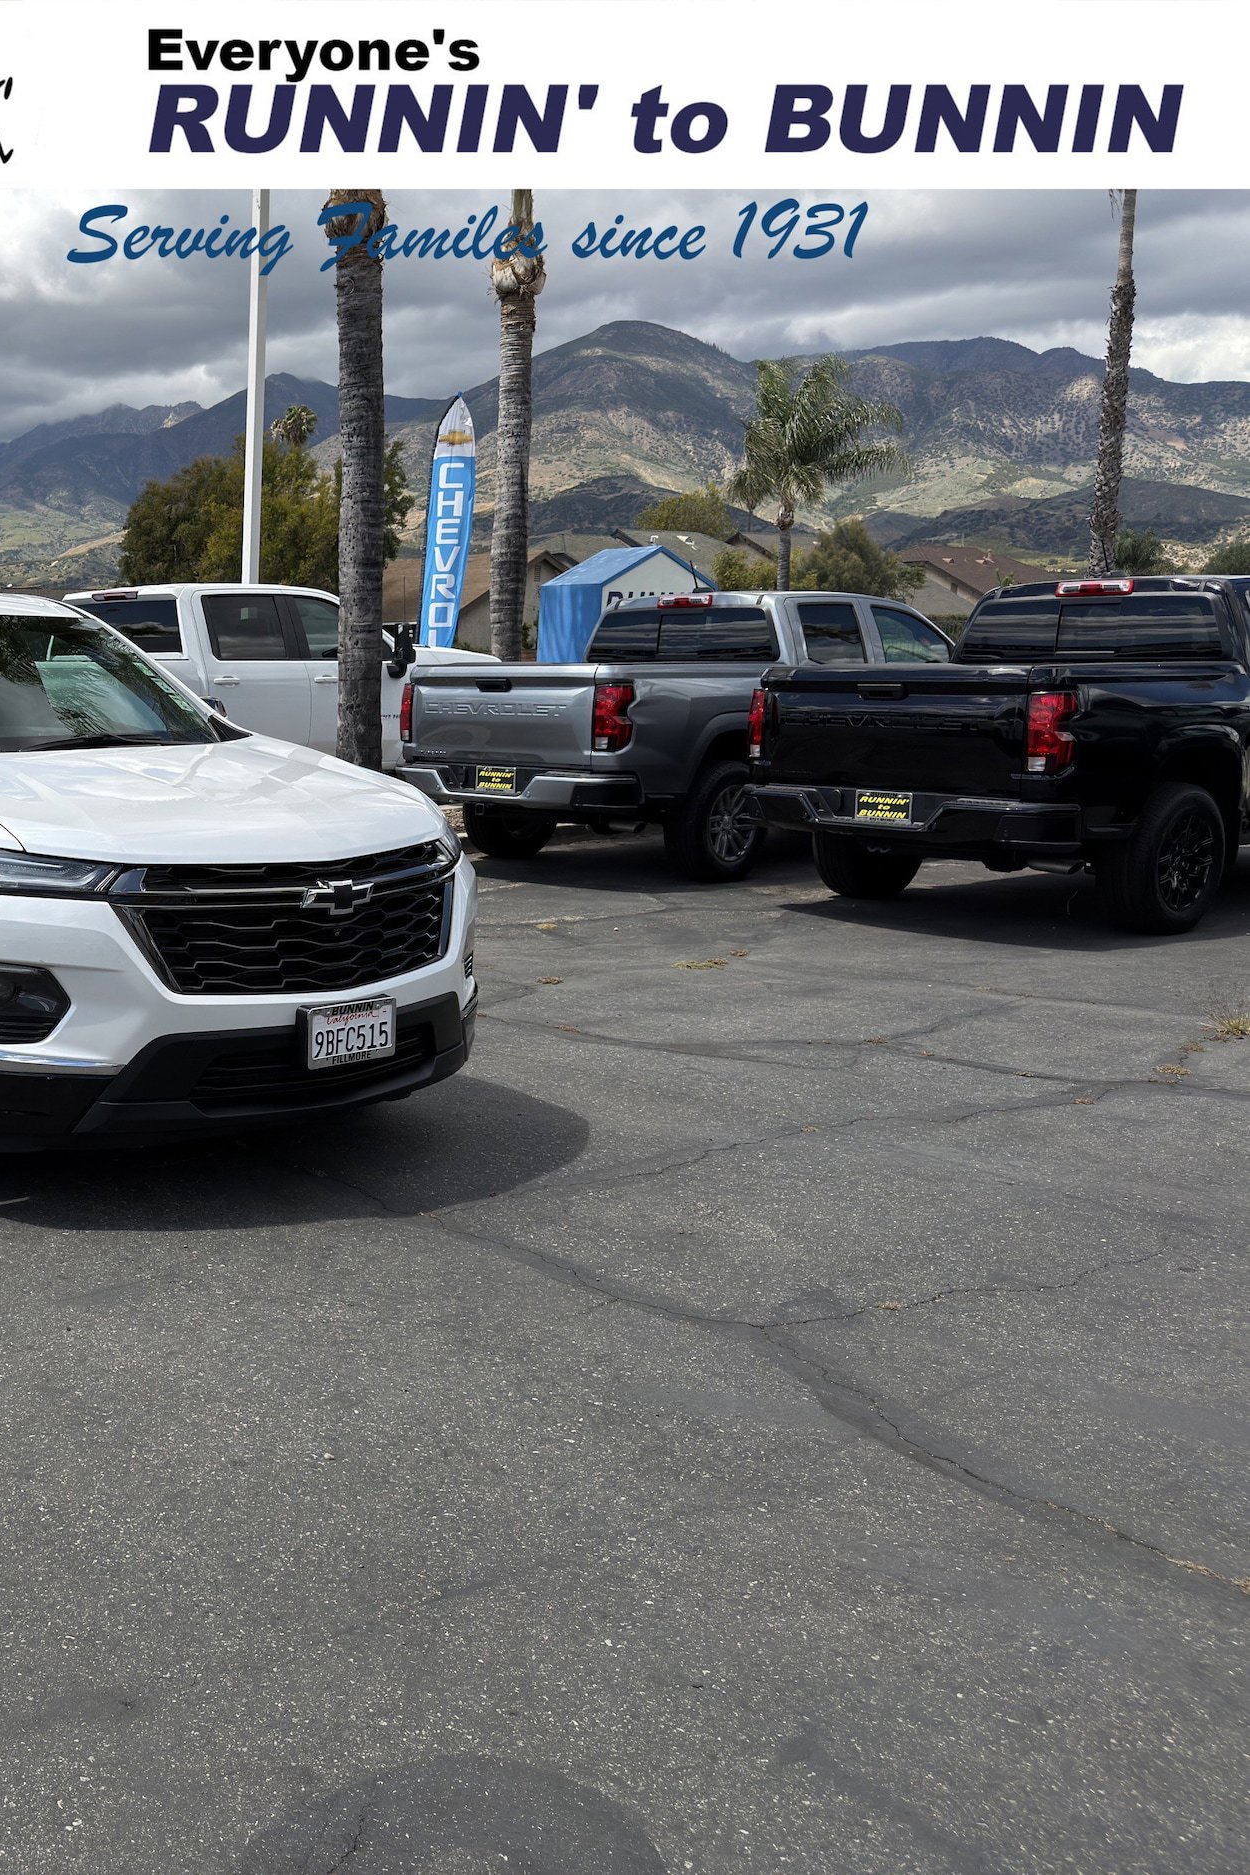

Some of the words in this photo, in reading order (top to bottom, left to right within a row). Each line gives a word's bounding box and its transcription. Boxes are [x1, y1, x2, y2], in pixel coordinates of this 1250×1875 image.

[425, 703, 566, 717] CHEVROLET
[859, 796, 910, 805] RUNNIN'
[858, 809, 907, 818] BUNNIN
[332, 1001, 374, 1016] BUNNIN
[314, 1021, 388, 1058] 9BFC515
[332, 1051, 372, 1065] FILLMORE
